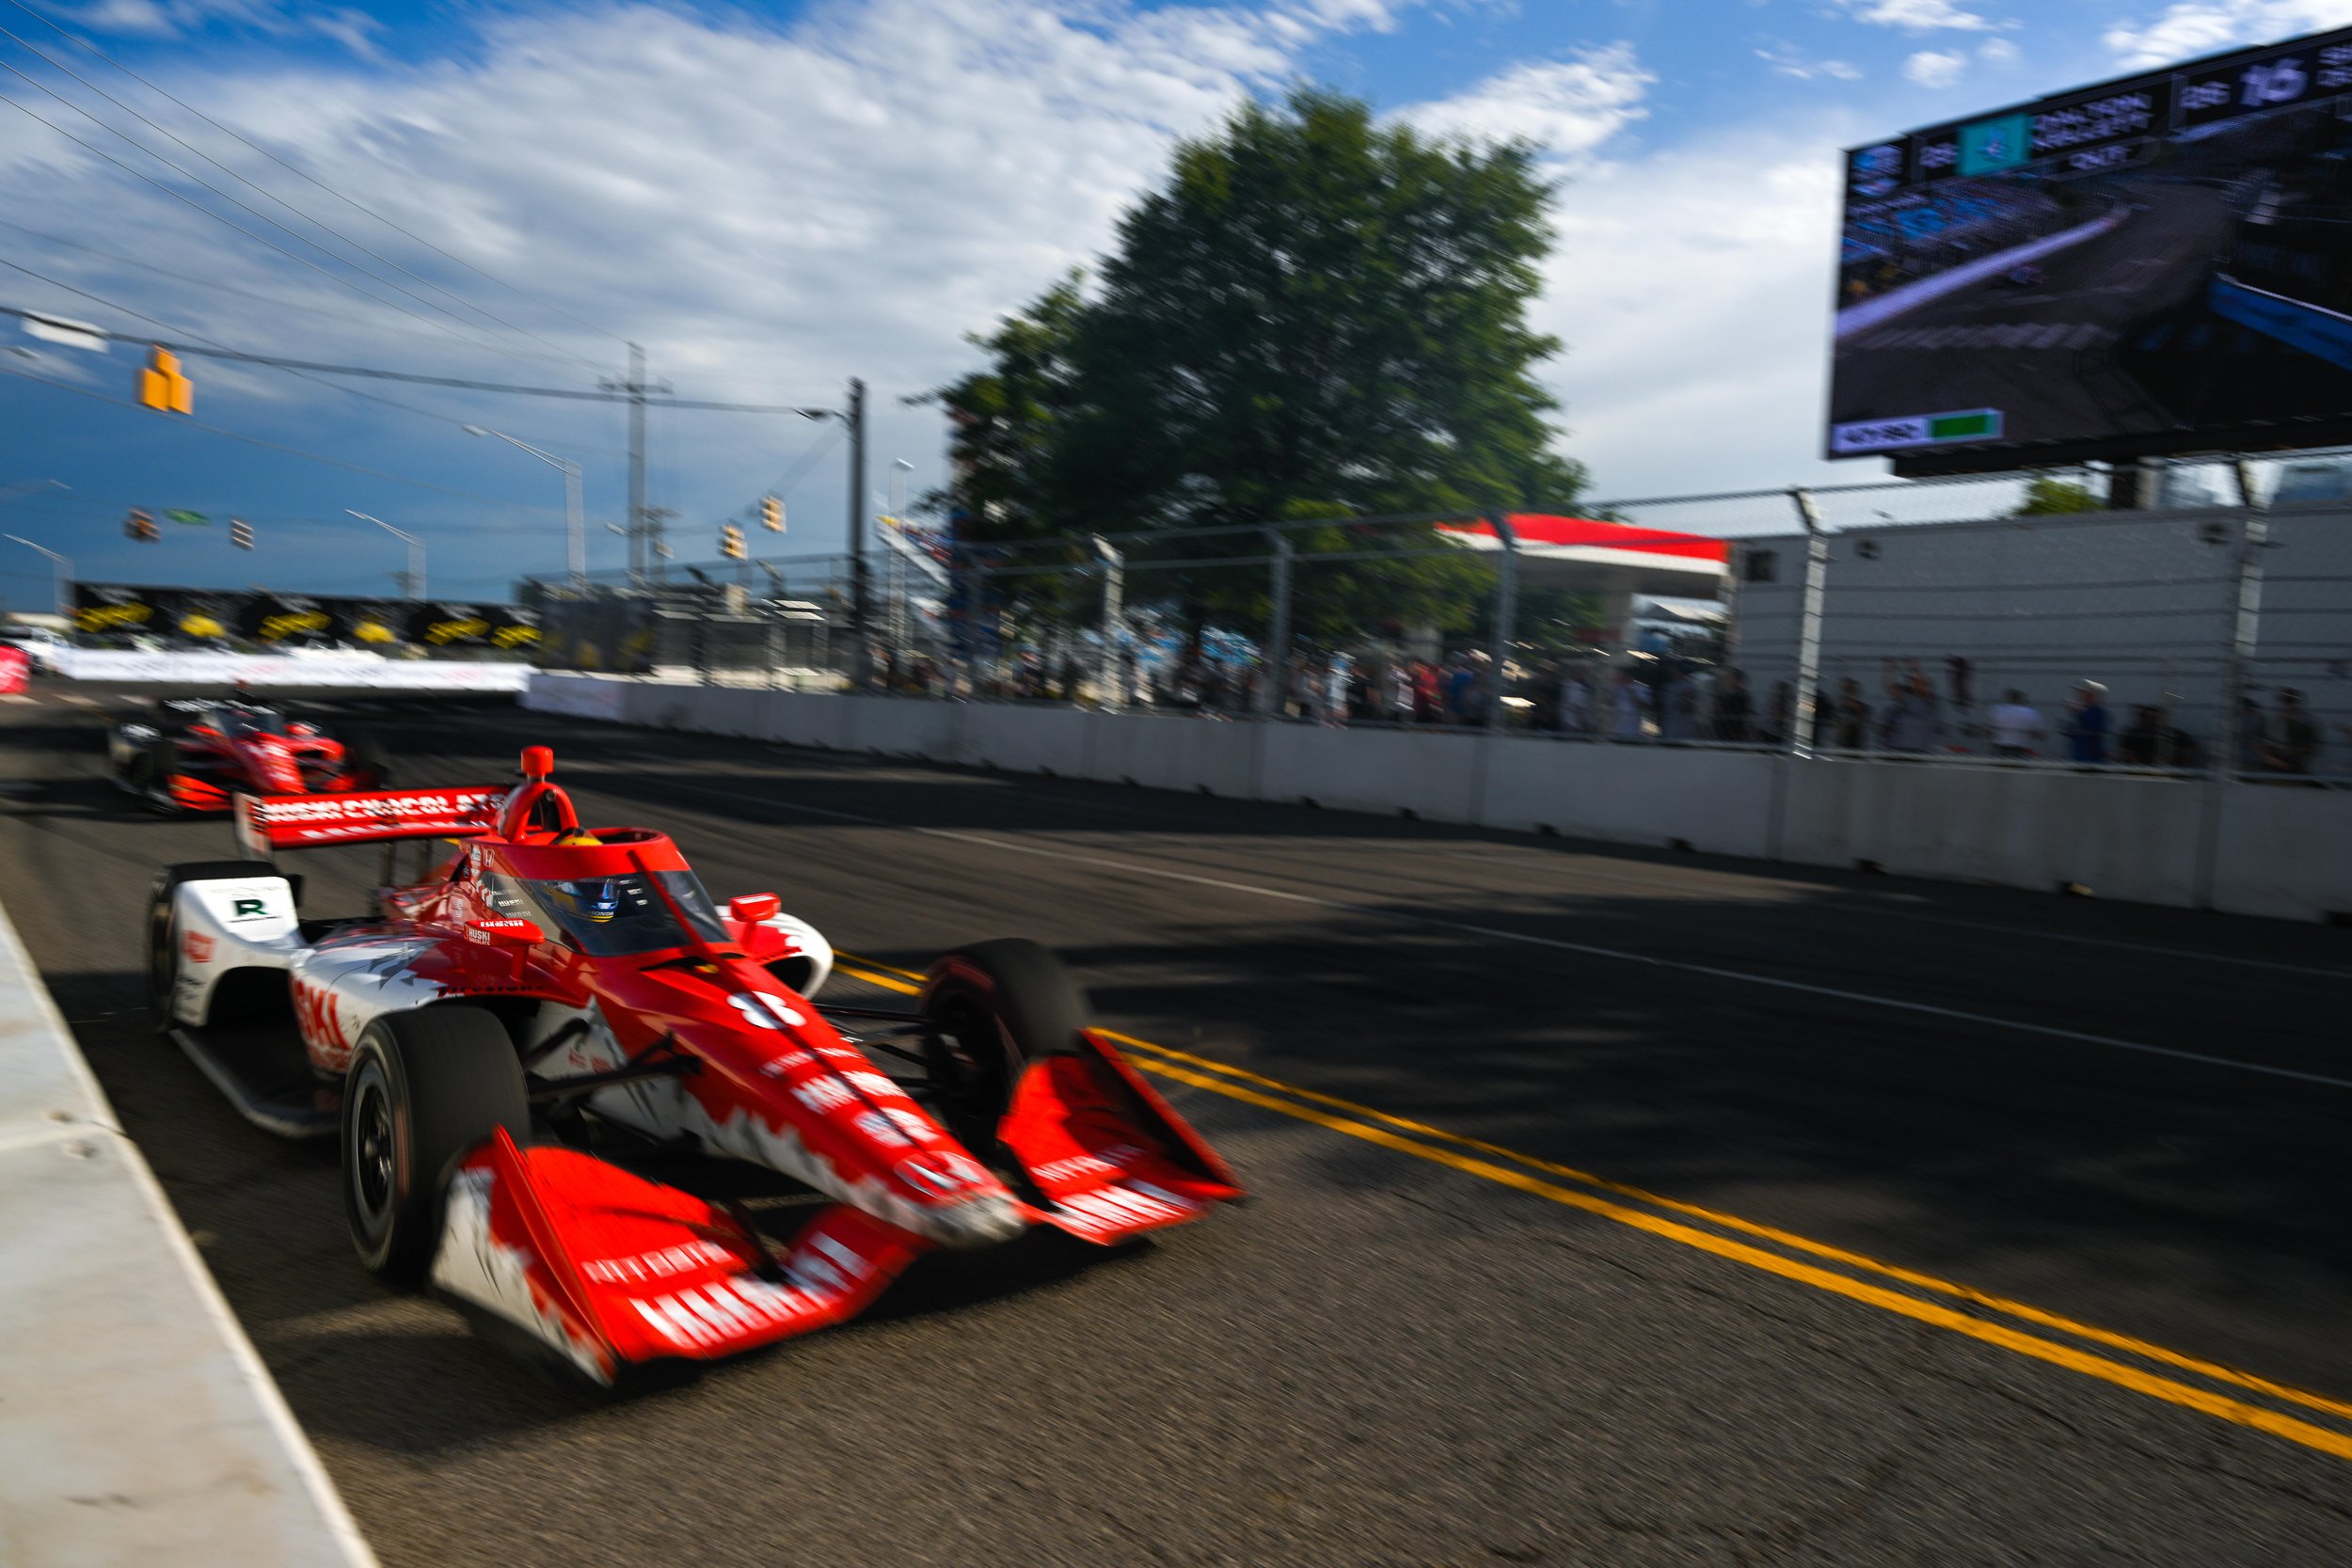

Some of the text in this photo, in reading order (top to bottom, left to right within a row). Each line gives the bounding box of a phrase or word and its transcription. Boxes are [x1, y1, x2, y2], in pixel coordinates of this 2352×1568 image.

[233, 898, 268, 917] R
[469, 927, 490, 942] HUSKI
[726, 990, 807, 1030] 8
